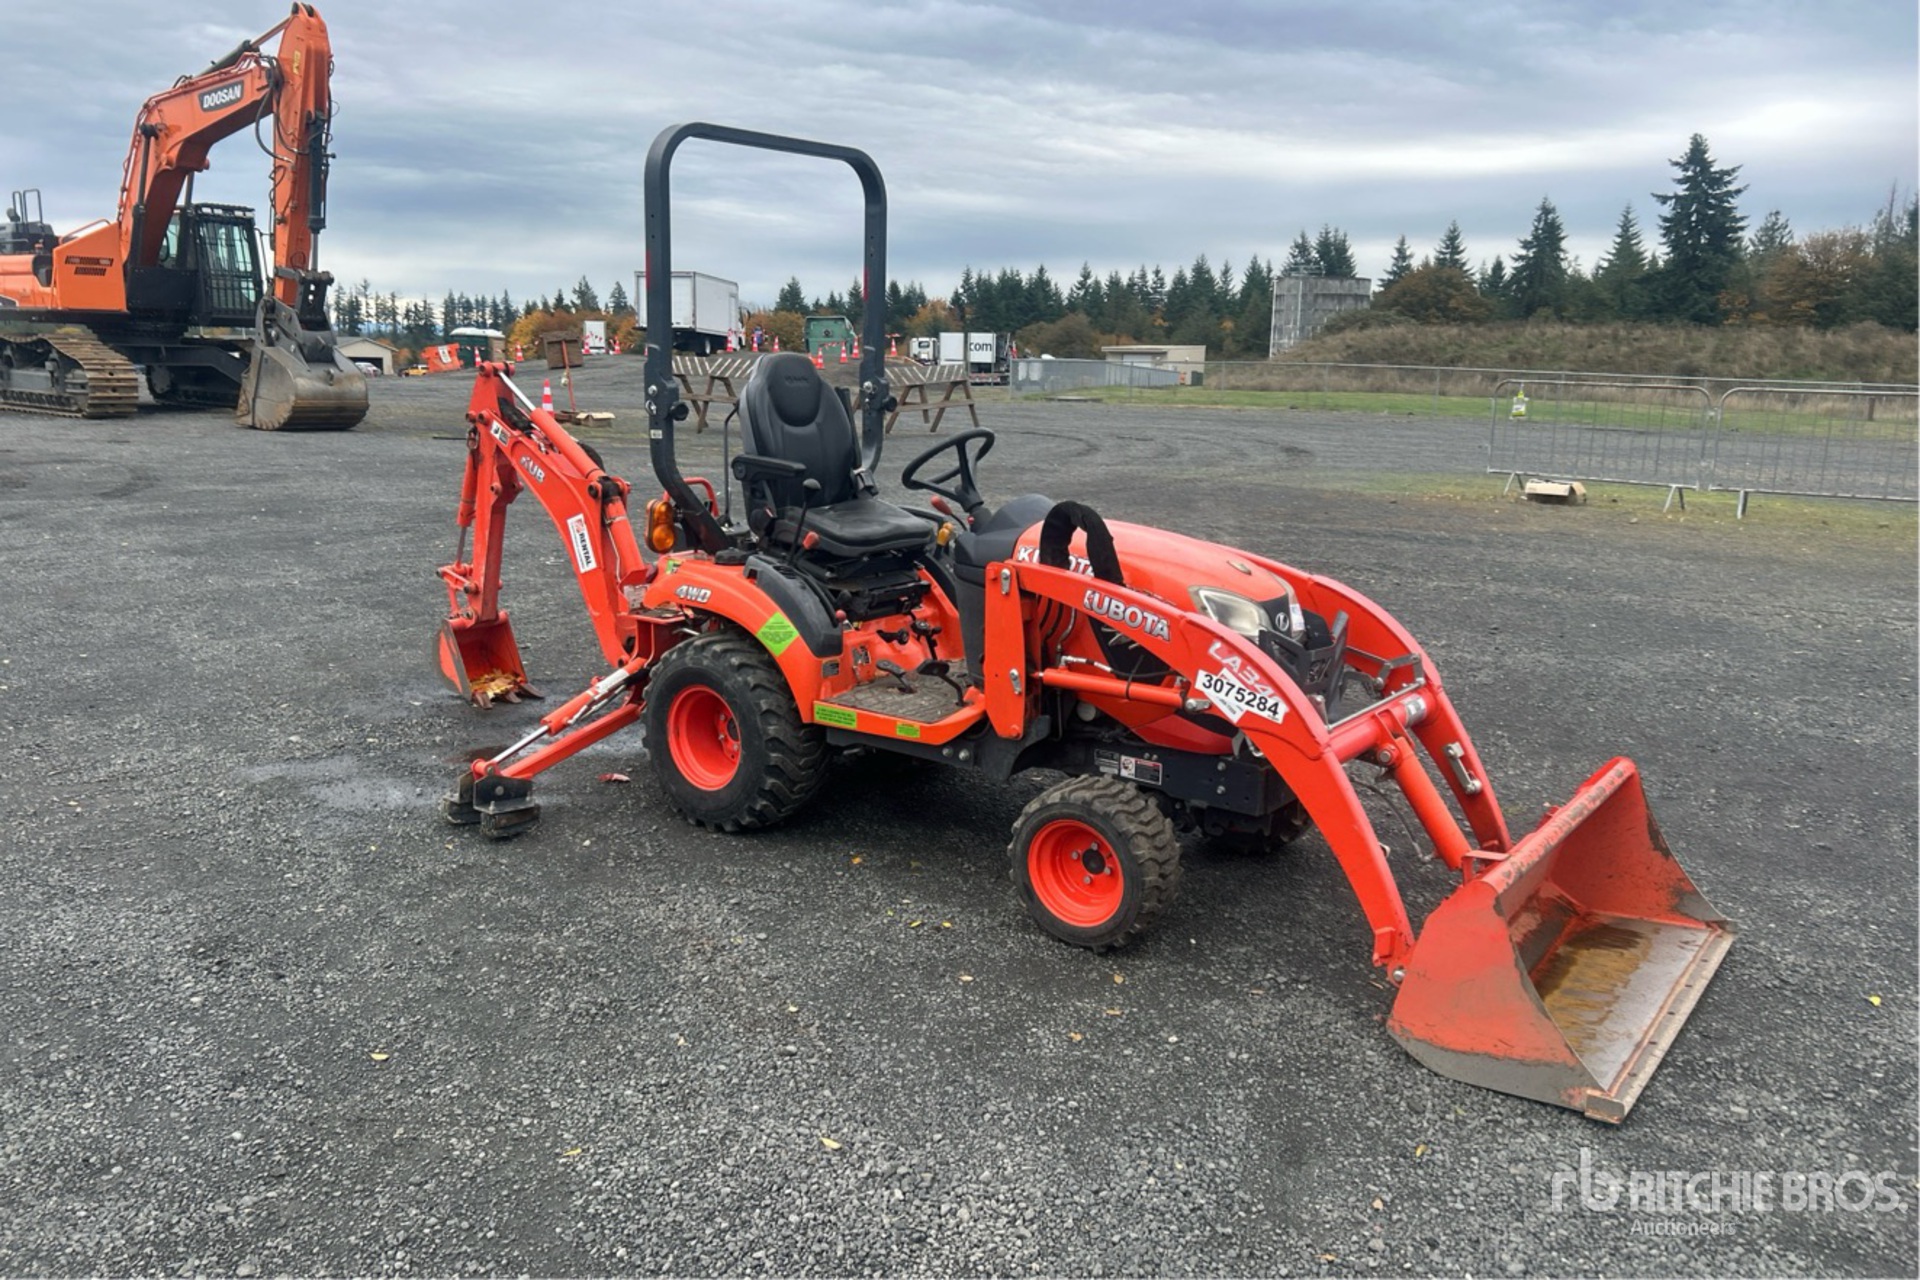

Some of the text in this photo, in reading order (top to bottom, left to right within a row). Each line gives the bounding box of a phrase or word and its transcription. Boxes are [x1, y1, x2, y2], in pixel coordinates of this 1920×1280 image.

[202, 85, 242, 109] DOOSAN
[578, 532, 593, 567] RENTAL
[675, 584, 712, 604] 4WD
[1083, 589, 1171, 642] KUBOTA
[1201, 673, 1280, 717] 3075284
[1208, 639, 1290, 713] LA34
